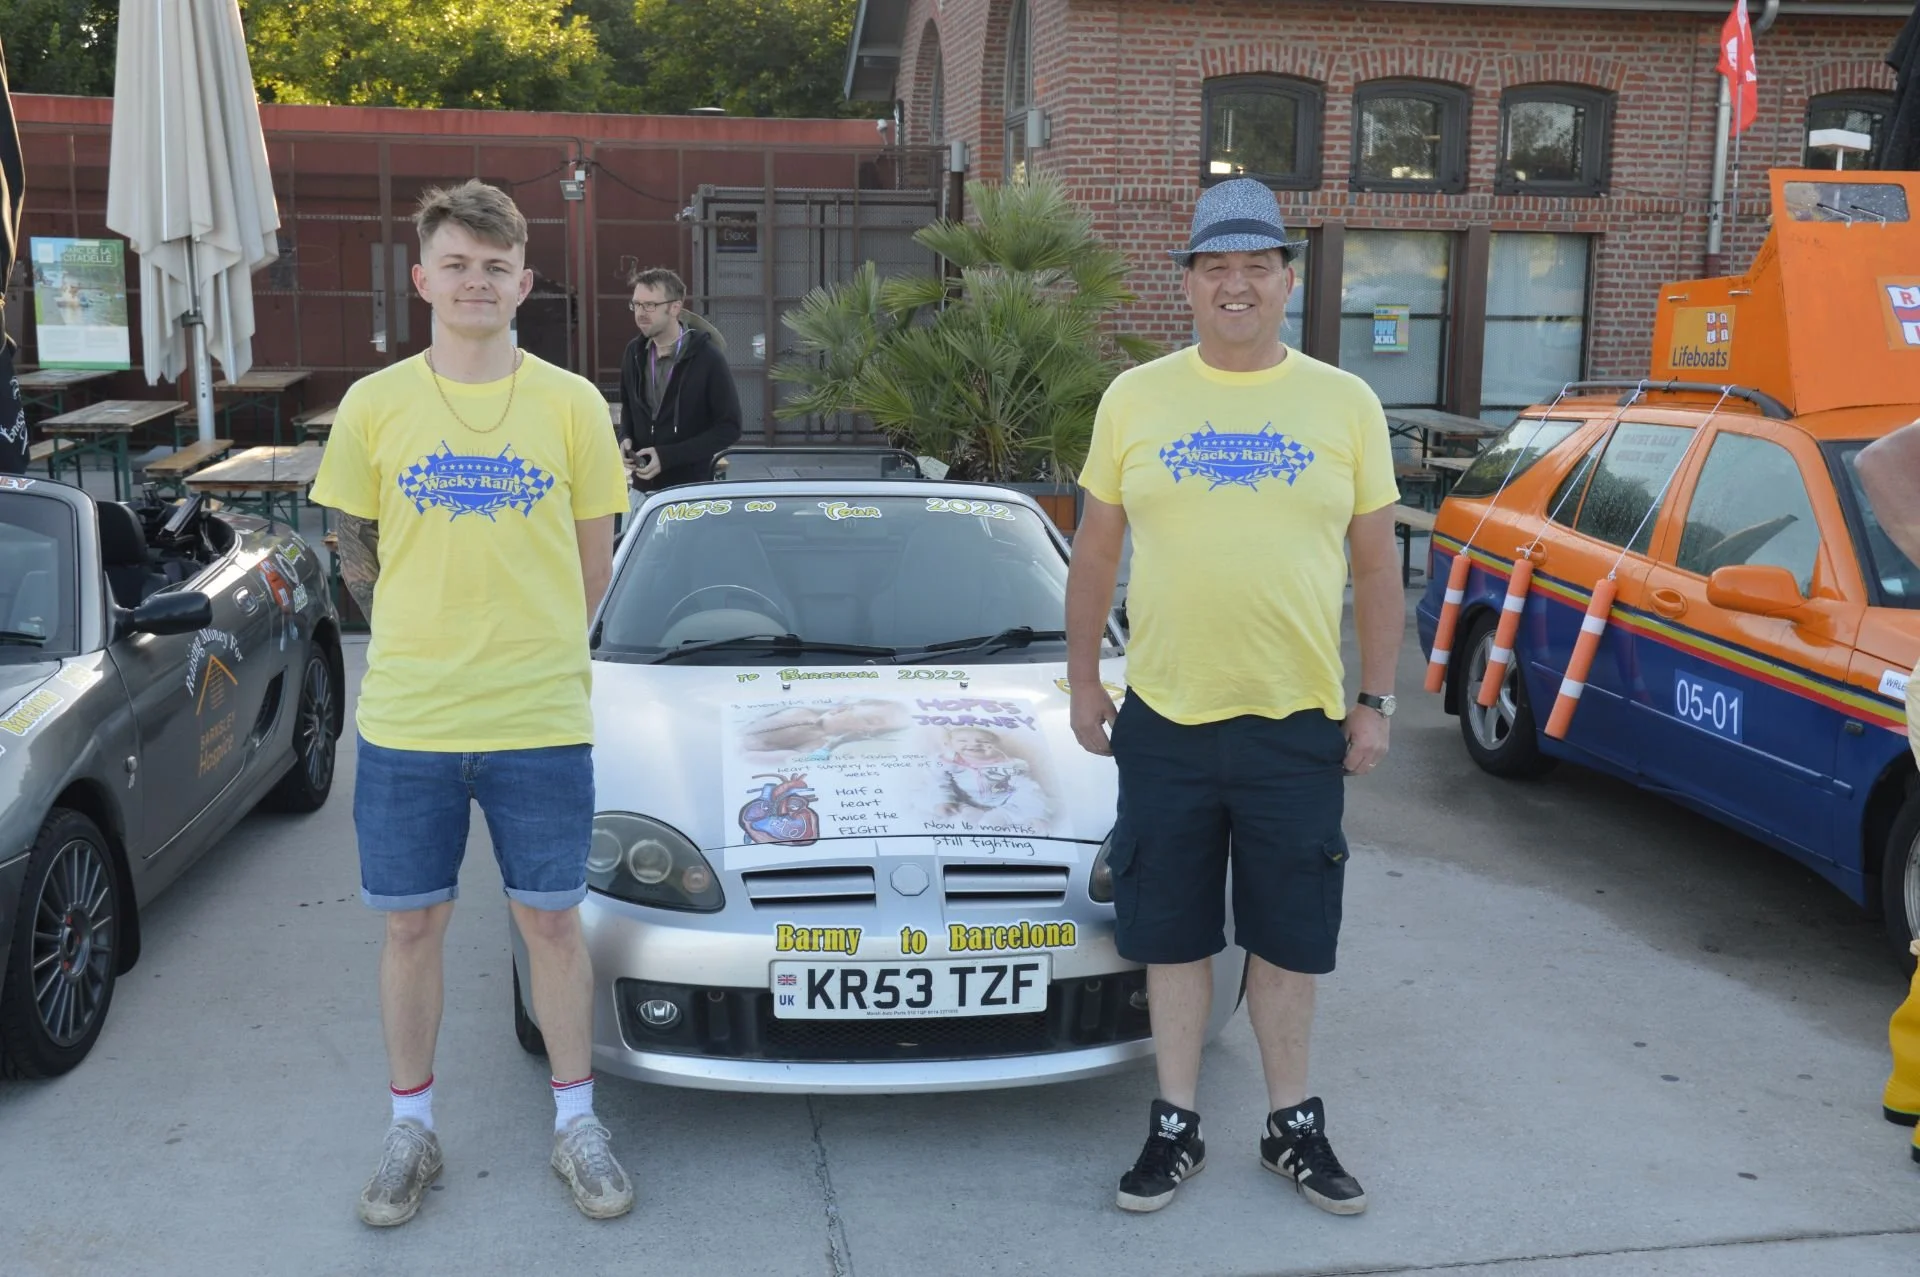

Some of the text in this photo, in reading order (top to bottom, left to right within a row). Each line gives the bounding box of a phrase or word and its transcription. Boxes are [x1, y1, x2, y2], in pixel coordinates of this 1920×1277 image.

[63, 254, 113, 263] CITADELLE
[86, 247, 99, 255] DE
[100, 247, 112, 255] LA
[1672, 345, 1728, 367] Lifeboats
[1186, 449, 1283, 466] Wacky Rally
[424, 475, 523, 495] Wacky Rally
[926, 498, 1015, 521] 2022
[186, 628, 243, 698] Raising Money For
[897, 669, 971, 681] 2022
[1676, 678, 1741, 736] 05-01
[911, 714, 1037, 731] JOURNEY
[777, 764, 811, 773] heart
[817, 763, 861, 772] surgery
[881, 761, 911, 769] space
[835, 786, 883, 796] Half a
[840, 798, 882, 808] heart
[828, 811, 899, 823] Twice the
[838, 825, 889, 835] FIGHT
[924, 821, 955, 830] Now
[979, 823, 1036, 835] months
[970, 835, 1035, 856] fighting
[776, 922, 1076, 955] Barmy to Barcelona
[807, 963, 1039, 1010] KR53 TZF
[778, 994, 795, 1006] UK
